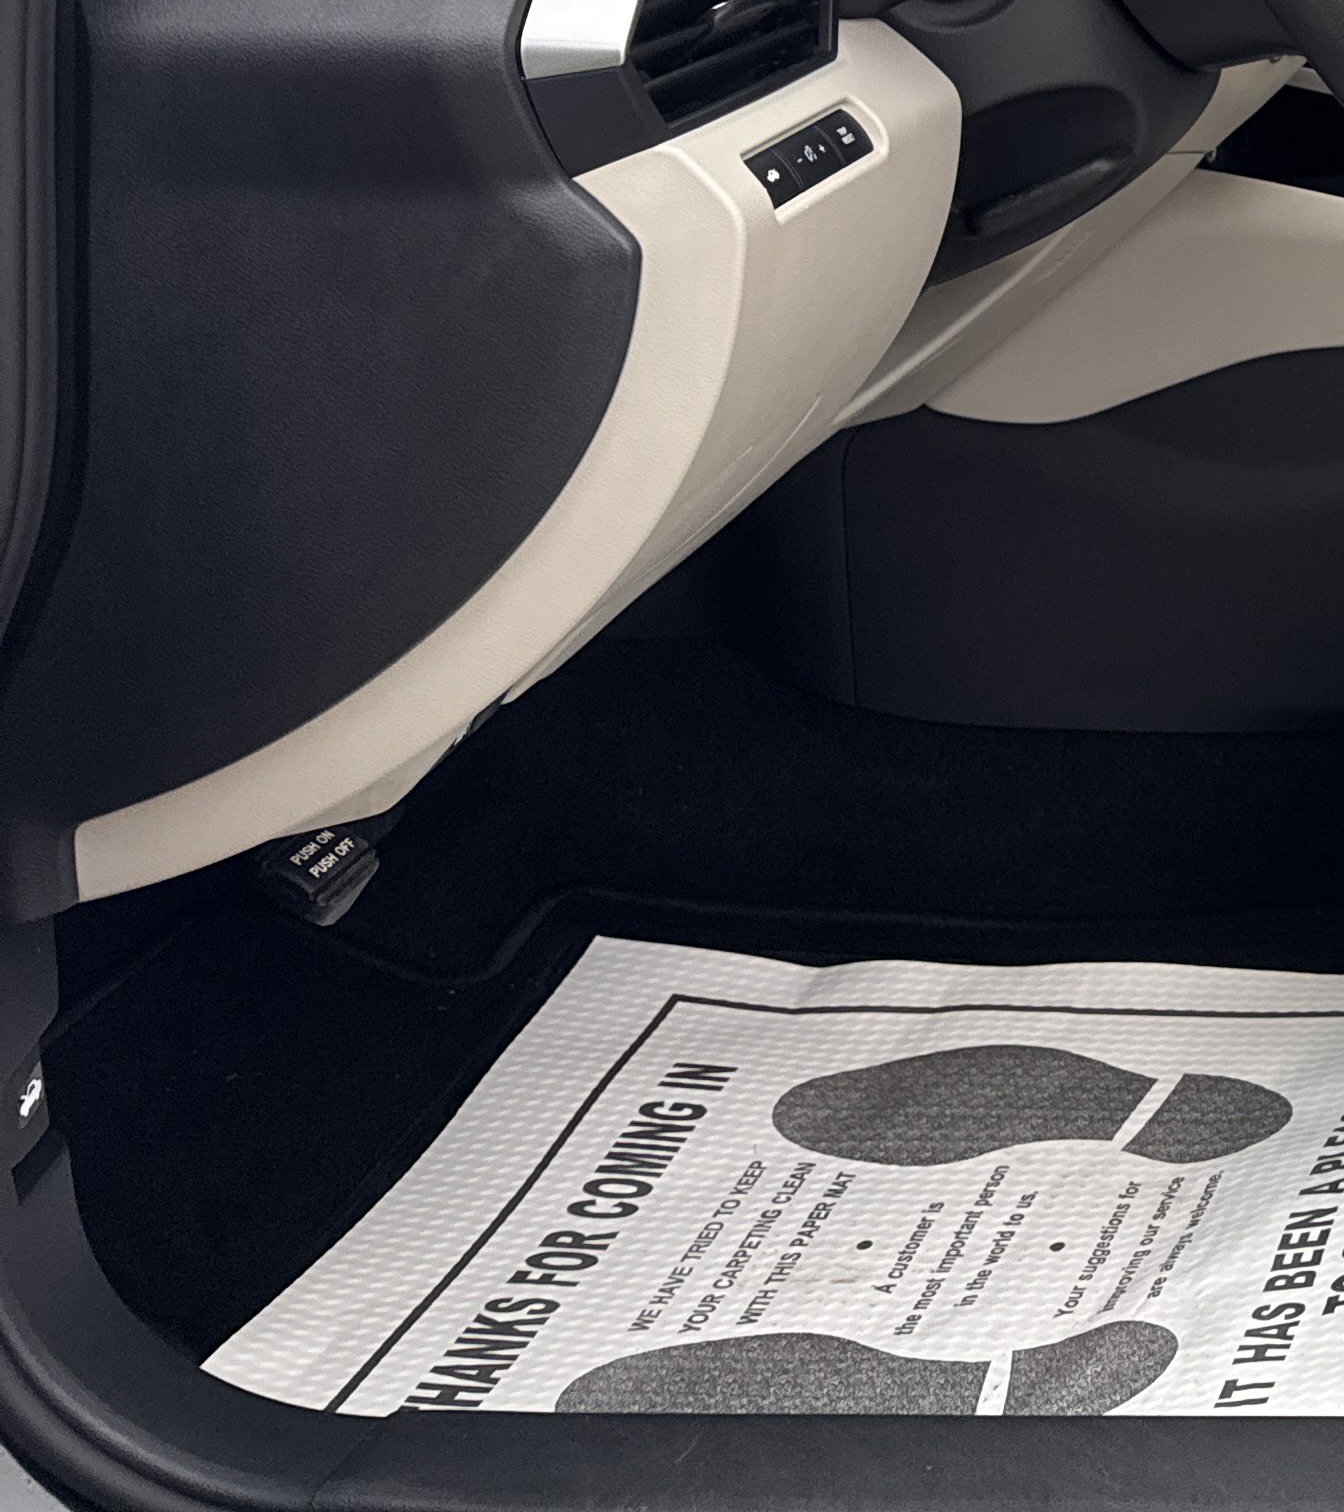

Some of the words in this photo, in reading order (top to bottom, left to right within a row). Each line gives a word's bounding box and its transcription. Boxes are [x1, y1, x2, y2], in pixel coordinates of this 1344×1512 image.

[290, 841, 321, 866] PUSH
[316, 830, 336, 844] ON
[308, 852, 339, 879] PUSH
[334, 837, 355, 857] OFF
[399, 1297, 561, 1410] HANKS
[506, 1230, 620, 1287] FOR
[567, 1101, 708, 1219] COMING
[657, 1062, 738, 1091] IN
[1003, 1213, 1025, 1226] to
[1140, 1224, 1160, 1246] our
[1152, 1176, 1185, 1220] service
[628, 1309, 662, 1331] WE
[651, 1267, 693, 1304] HAVE
[680, 1221, 724, 1262] TRIED
[712, 1199, 741, 1218] TO
[730, 1160, 767, 1195] KEEP
[678, 1294, 725, 1334] YOUR
[713, 1209, 782, 1289] CARPETING
[771, 1162, 817, 1205] CLEAN
[736, 1289, 779, 1325] WITH
[764, 1252, 801, 1284] THIS
[789, 1201, 837, 1247] PAPER
[823, 1171, 856, 1198] MAT
[873, 1282, 897, 1294] A
[888, 1217, 935, 1279] customer
[921, 1201, 945, 1213] is
[894, 1314, 922, 1335] the
[913, 1277, 946, 1310] most
[931, 1210, 984, 1273] important
[974, 1165, 1010, 1206] person
[983, 1231, 1016, 1266] world
[1053, 1285, 1086, 1318] Your
[1079, 1203, 1131, 1281] suggestions
[1118, 1181, 1142, 1199] for
[1147, 1276, 1167, 1299] are
[1160, 1232, 1193, 1272] always
[1263, 1205, 1339, 1292] BEEN
[954, 1294, 978, 1307] in
[965, 1269, 993, 1291] the
[1232, 1302, 1306, 1365] HAS
[1213, 1378, 1276, 1408] IT
